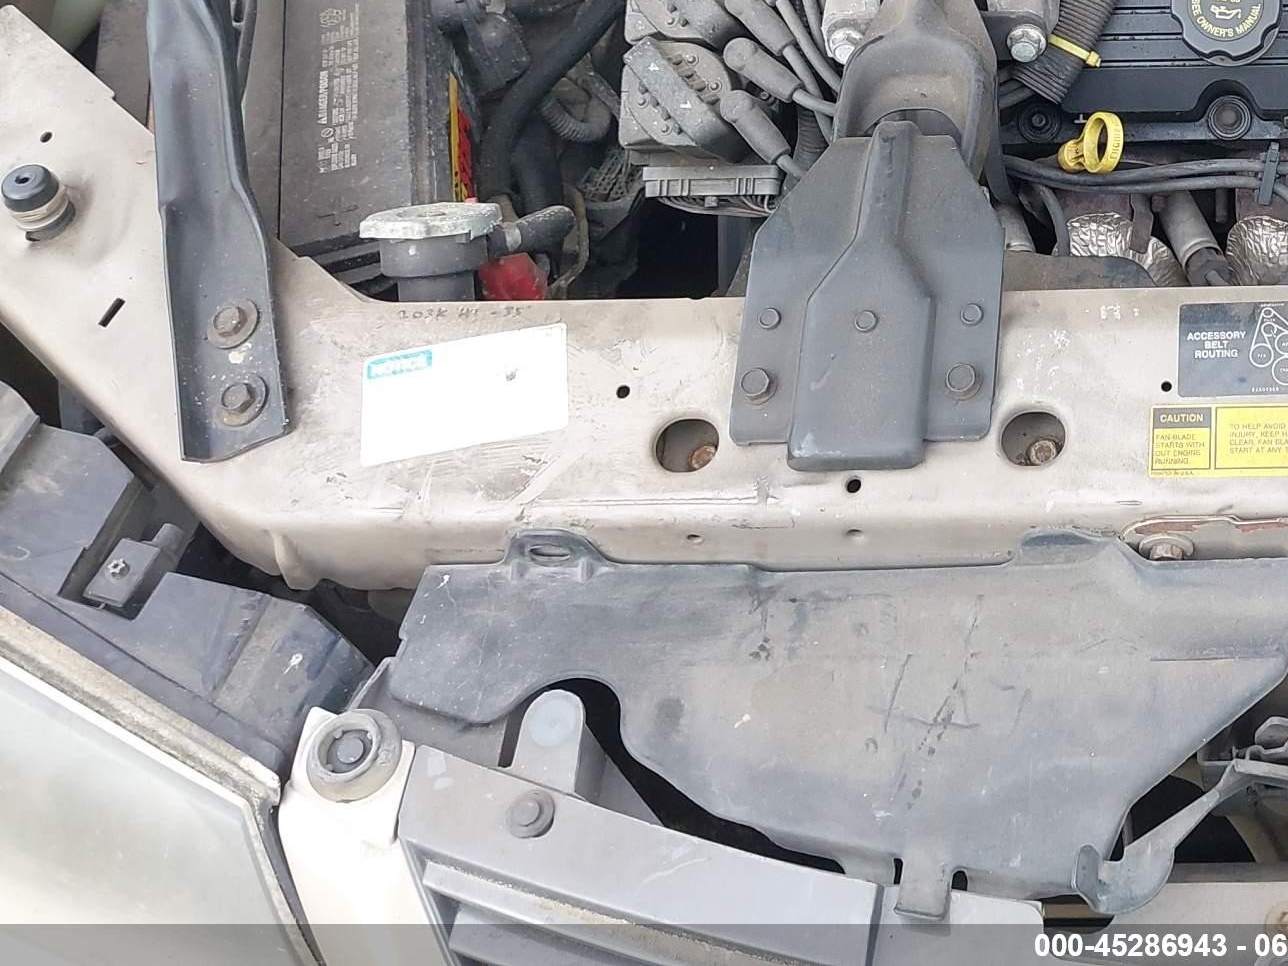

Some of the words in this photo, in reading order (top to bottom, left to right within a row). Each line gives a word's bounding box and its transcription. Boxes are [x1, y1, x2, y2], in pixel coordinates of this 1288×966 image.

[1197, 16, 1234, 38] OWNER'S
[1235, 3, 1261, 35] MANUAL
[1186, 330, 1247, 341] ACCESSORY
[1204, 340, 1229, 349] BELT
[1194, 349, 1239, 359] ROUTING
[1159, 413, 1204, 423] CAUTION
[1263, 422, 1286, 430] AVOID
[1260, 430, 1280, 438] KEEP
[1155, 441, 1184, 449] STARTS
[1185, 441, 1205, 449] WITH
[1154, 449, 1170, 457] OUT
[1173, 449, 1201, 457] ENGINE
[1255, 446, 1265, 454] AT
[1267, 446, 1282, 454] ANY
